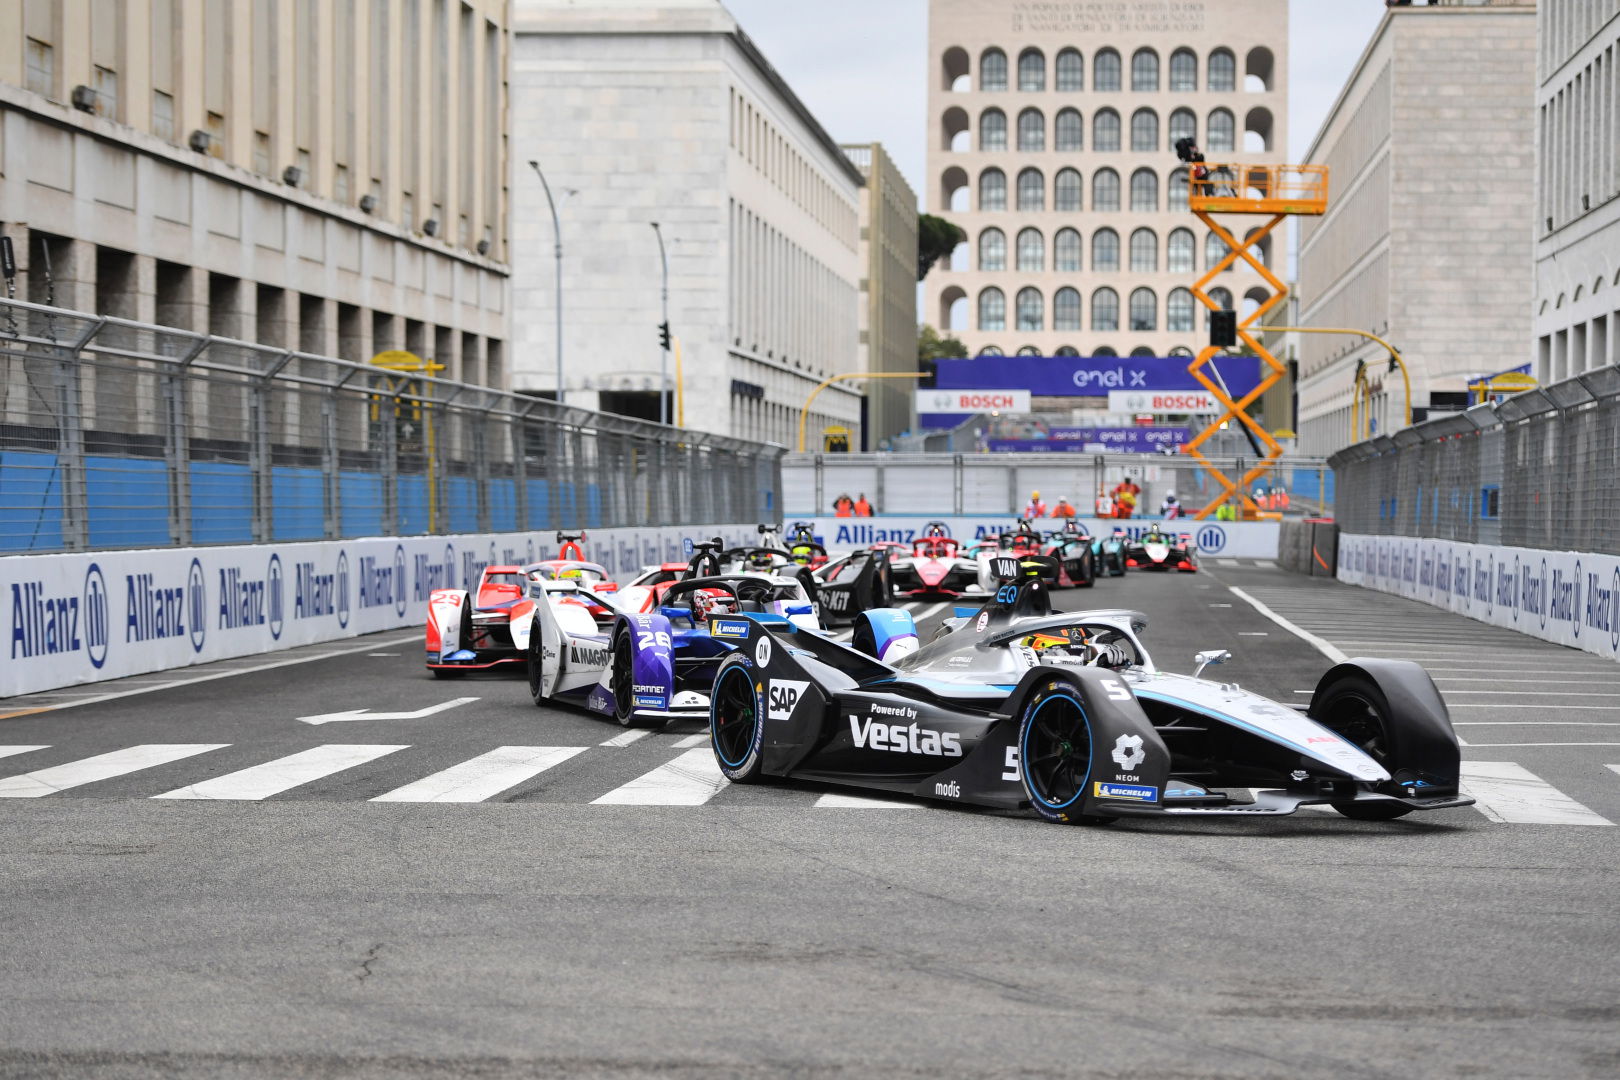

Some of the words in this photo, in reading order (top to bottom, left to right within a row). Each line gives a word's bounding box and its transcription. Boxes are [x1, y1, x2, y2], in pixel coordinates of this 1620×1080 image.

[1073, 367, 1124, 387] enel
[960, 395, 1014, 409] BOSCH
[1153, 396, 1207, 409] BOSCH
[1100, 430, 1126, 442] enel
[1145, 430, 1172, 442] enel
[836, 523, 915, 545] Allianz
[997, 560, 1017, 577] VAN
[294, 562, 334, 619] Allianz
[359, 556, 393, 609] Allianz
[1522, 565, 1540, 615] Allianz
[218, 567, 265, 630] Allianz
[432, 594, 461, 608] 29
[996, 584, 1018, 604] EQ
[1550, 568, 1573, 622] Allianz
[1586, 572, 1611, 632] Allianz
[126, 572, 185, 643] Allianz
[11, 580, 81, 660] Allianz
[722, 623, 746, 633] MICHELIN
[637, 631, 672, 651] 26
[759, 644, 769, 661] ON
[632, 684, 665, 694] FORTINET
[769, 686, 798, 712] SAP
[1100, 680, 1132, 700] 5
[871, 703, 906, 717] Powered
[907, 706, 918, 720] by
[849, 714, 963, 757] Vestas
[1002, 745, 1021, 782] 5
[1115, 774, 1140, 783] NEOM
[935, 780, 961, 798] modis
[1110, 788, 1153, 798] MICHELIN
